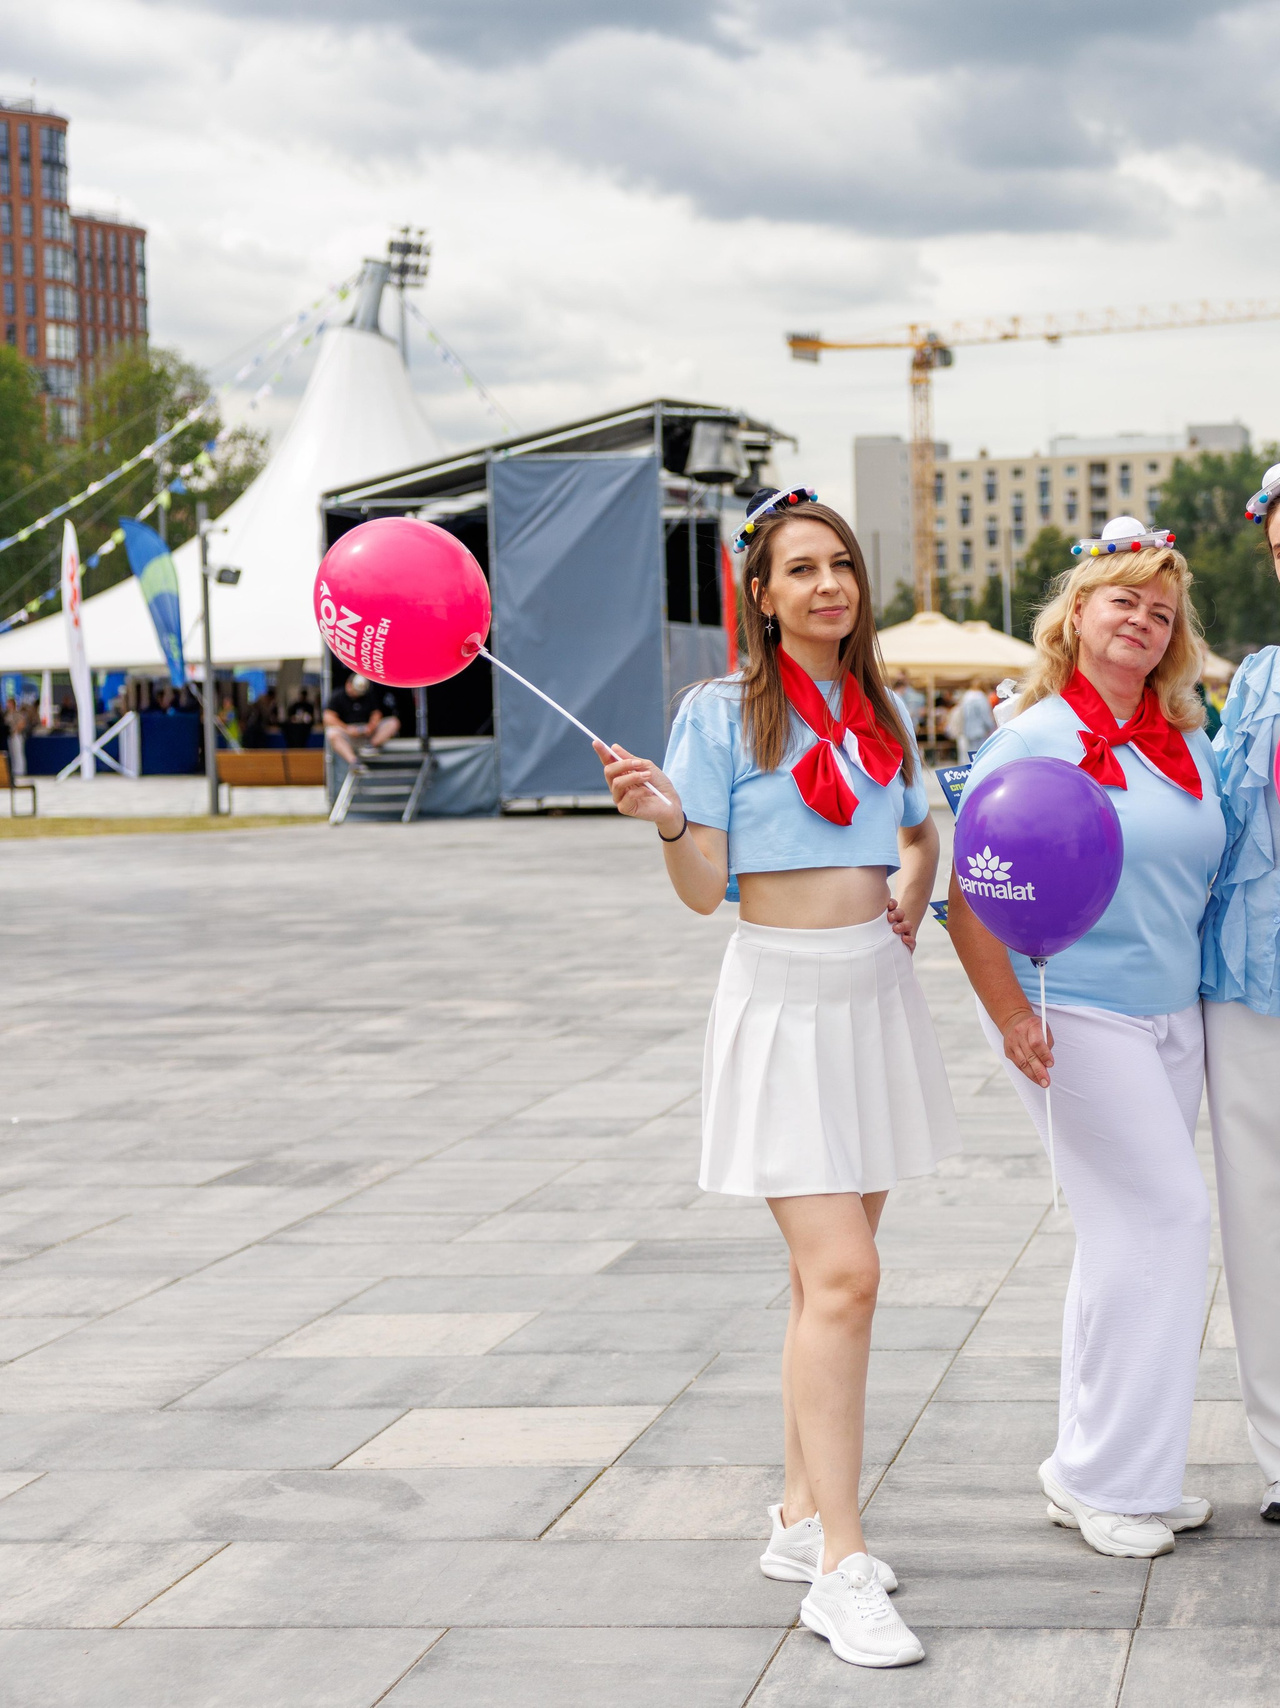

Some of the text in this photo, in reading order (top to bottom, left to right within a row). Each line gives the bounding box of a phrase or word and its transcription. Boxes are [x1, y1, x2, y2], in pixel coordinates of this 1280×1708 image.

[335, 605, 363, 666] TEIN
[361, 624, 375, 672] МОЛОКО
[958, 874, 1036, 901] parmalat
